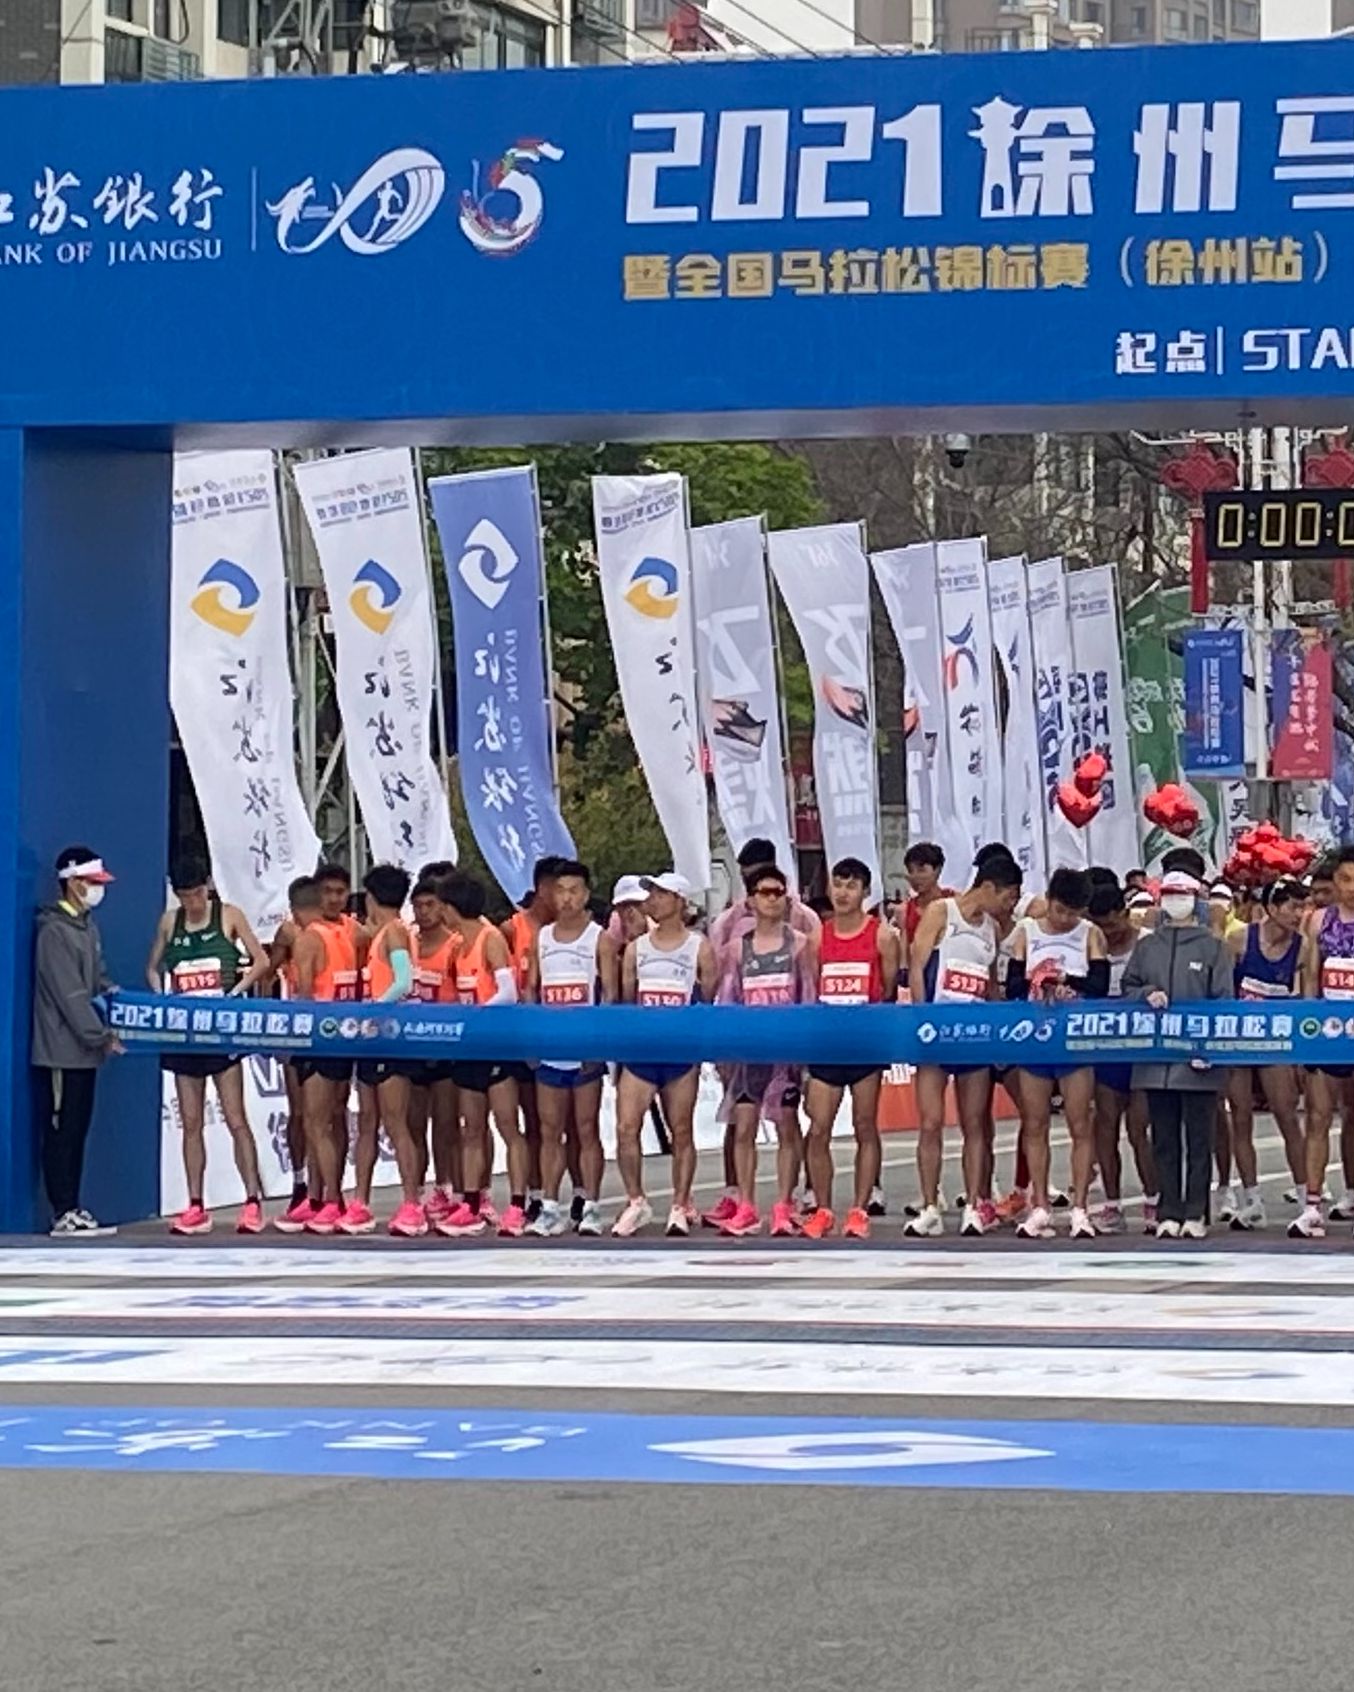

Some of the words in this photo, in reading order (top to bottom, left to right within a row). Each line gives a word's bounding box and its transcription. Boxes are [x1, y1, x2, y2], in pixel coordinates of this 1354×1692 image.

[0, 244, 43, 264] NK
[56, 241, 93, 264] OF
[108, 239, 222, 266] JIANGSU
[1115, 330, 1207, 375] 起点
